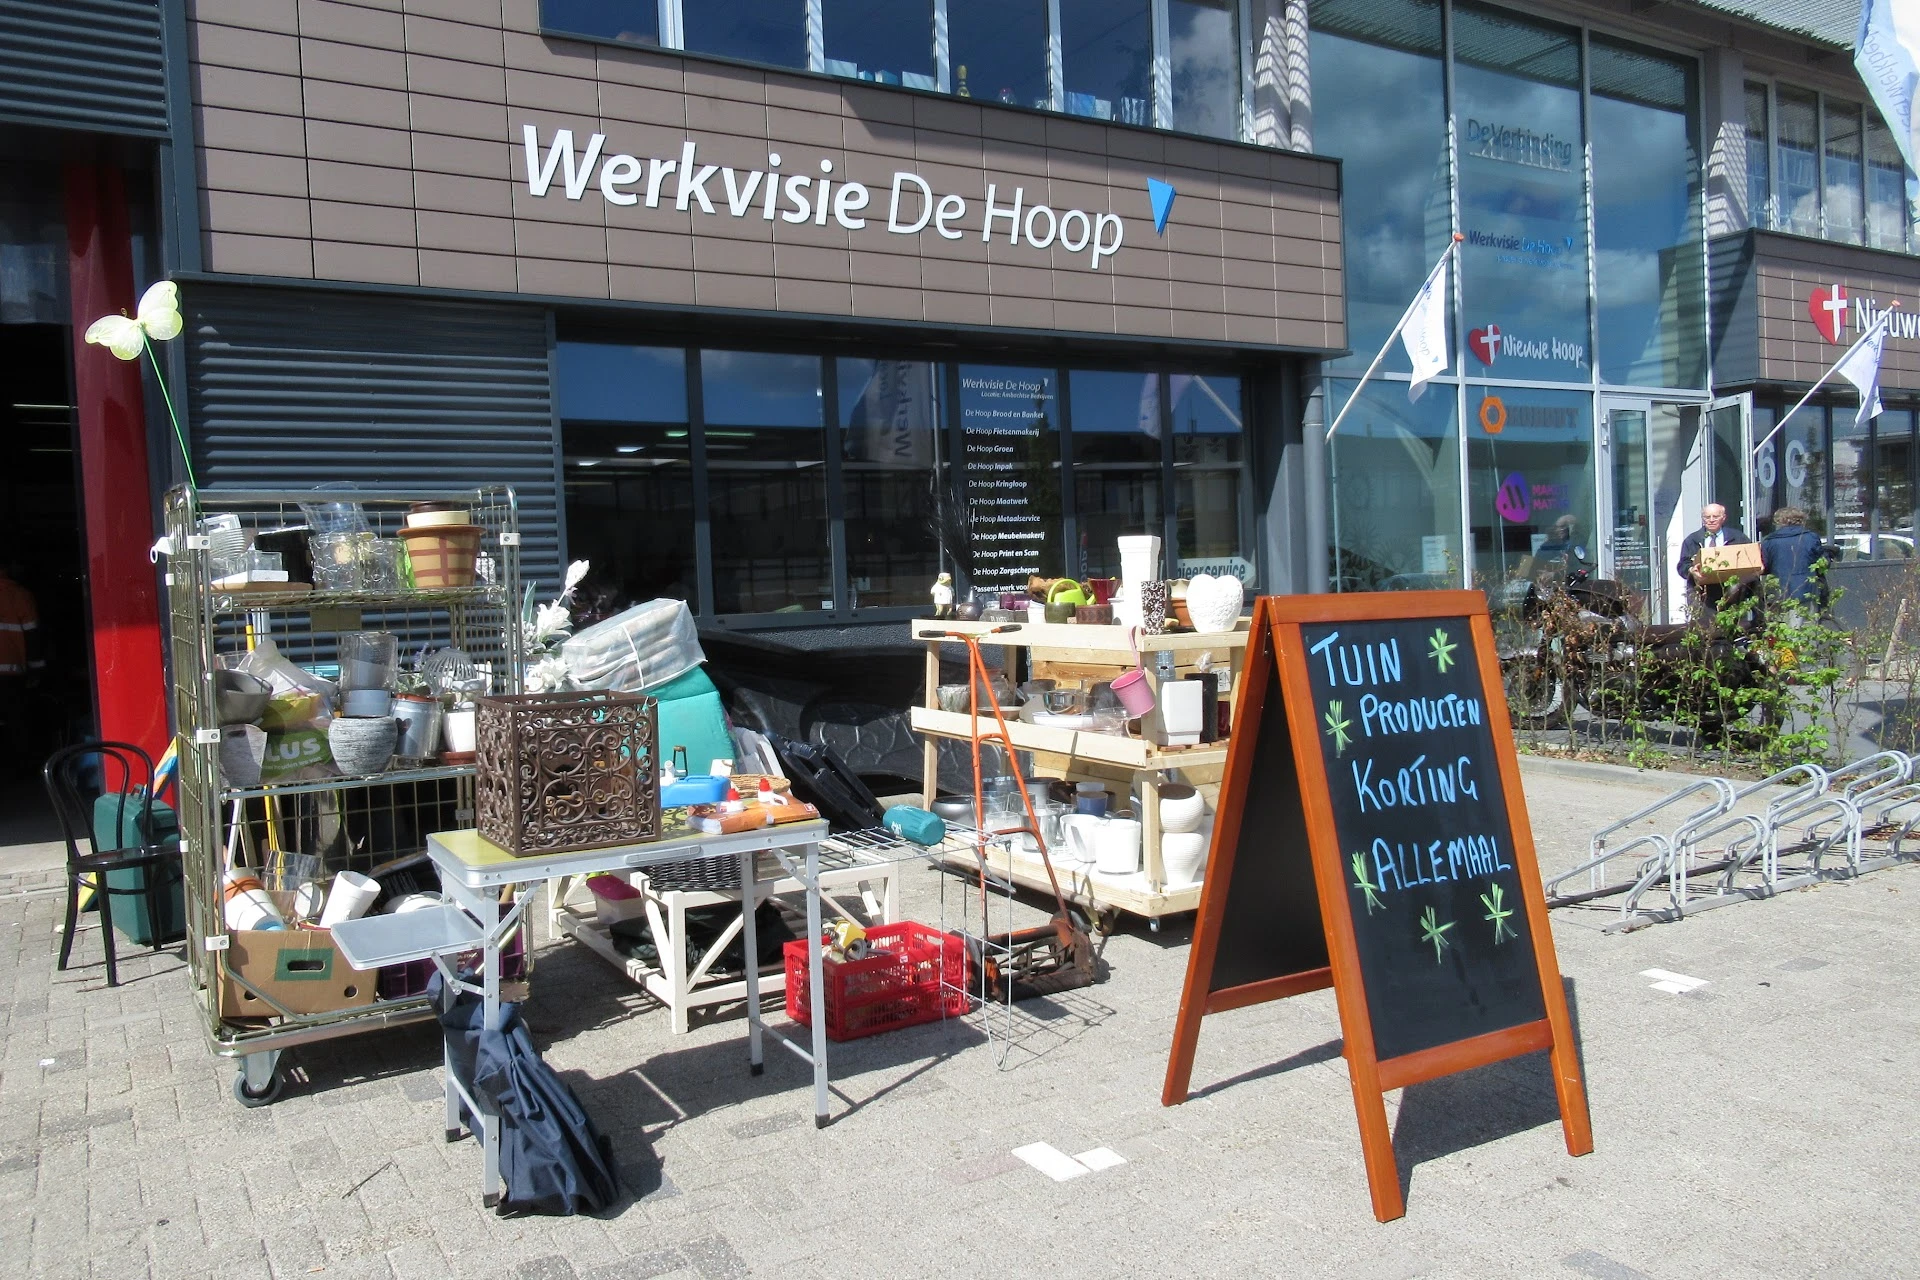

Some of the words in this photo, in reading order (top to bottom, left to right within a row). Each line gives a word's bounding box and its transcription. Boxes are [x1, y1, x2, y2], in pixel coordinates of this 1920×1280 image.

[522, 124, 869, 230] Werkvisie
[888, 171, 966, 240] De
[982, 183, 1124, 270] Hoop
[1469, 229, 1520, 250] Werkvisie
[1855, 297, 1920, 339] Nieuw
[1503, 334, 1549, 361] Nieuwe
[1552, 336, 1583, 368] Hoop
[962, 378, 1004, 390] Werkvisie
[1005, 380, 1017, 391] De
[1018, 381, 1041, 393] Hoop
[975, 409, 991, 418] Hoop
[992, 409, 1012, 418] Brood
[1021, 410, 1044, 418] Banket
[976, 427, 992, 436] Hoop
[993, 427, 1040, 437] Fietsenmakerij
[976, 445, 993, 453] Hoop
[977, 463, 994, 471] Hoop
[994, 463, 1014, 471] Inpak
[978, 480, 995, 489] Hoop
[996, 480, 1027, 489] Kringloop
[979, 498, 995, 506] Hoop
[996, 497, 1029, 505] Maatwerk
[980, 515, 996, 524] Hoop
[997, 514, 1040, 522] Metaalservice
[980, 533, 997, 541] Hoop
[998, 532, 1045, 540] Meubelmakerij
[973, 550, 980, 558] De
[981, 550, 998, 558] Hoop
[1024, 549, 1039, 557] Scan
[981, 568, 998, 576] Hoop
[999, 566, 1040, 576] Zorgschepen
[1310, 631, 1401, 686] TUIN
[1359, 693, 1481, 737] PRODUCTEN
[1352, 754, 1479, 813] KORTING
[1372, 834, 1511, 892] ALLEMAAL
